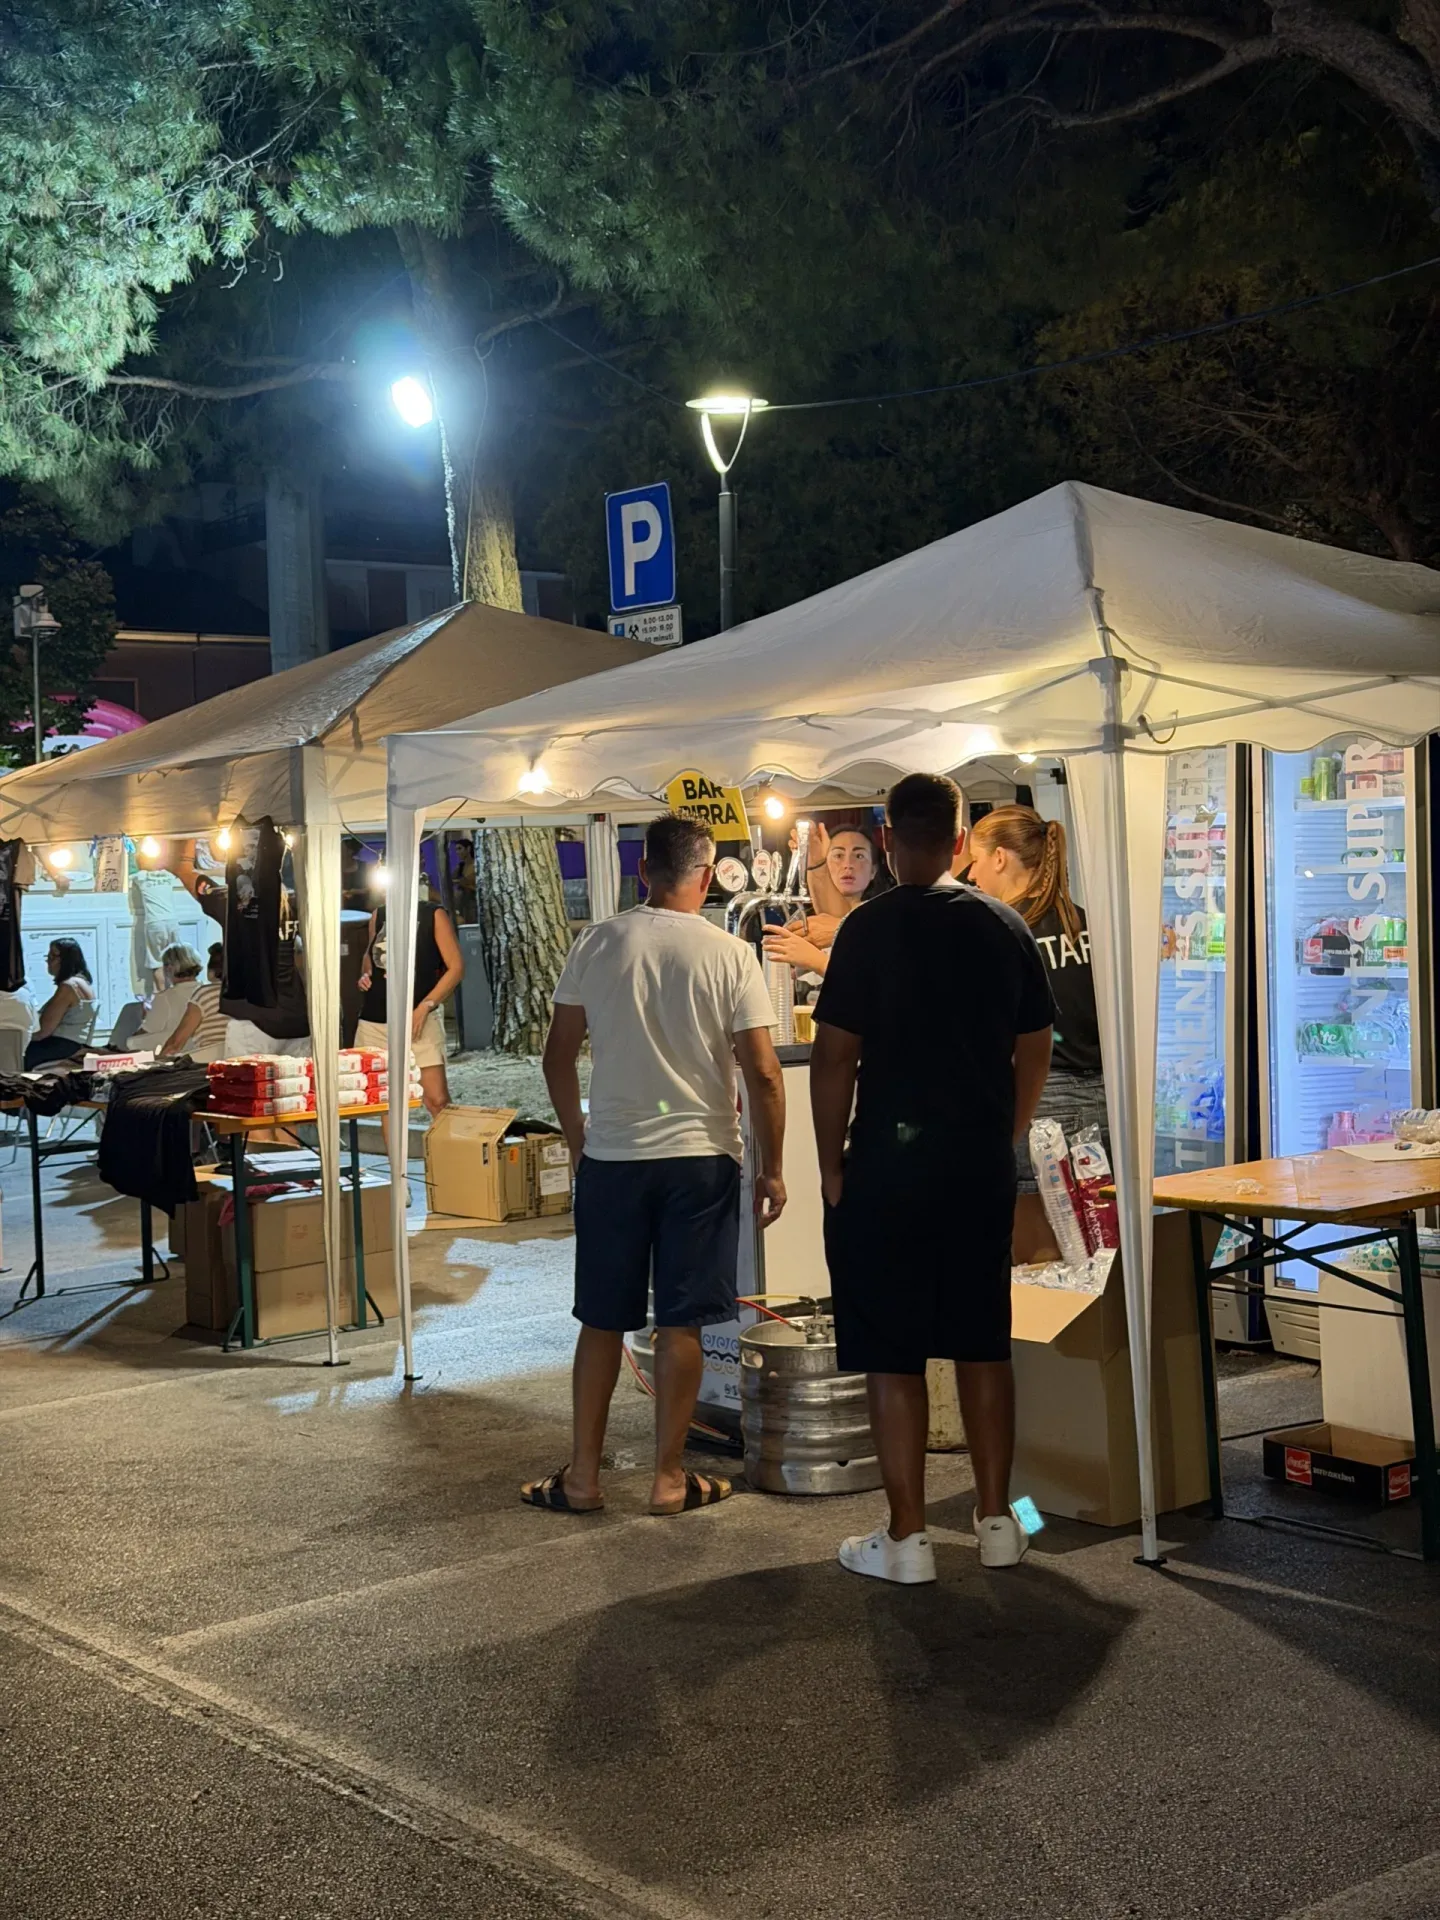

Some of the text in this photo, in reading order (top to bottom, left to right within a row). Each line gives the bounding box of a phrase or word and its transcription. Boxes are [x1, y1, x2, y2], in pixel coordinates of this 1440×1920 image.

[620, 500, 663, 597] P
[682, 777, 726, 800] BAR
[1345, 740, 1387, 901] SUPER
[1035, 931, 1091, 970] TAF
[1174, 750, 1210, 1168] TENNENT'S SUPER
[1347, 913, 1396, 1135] NNENT'S
